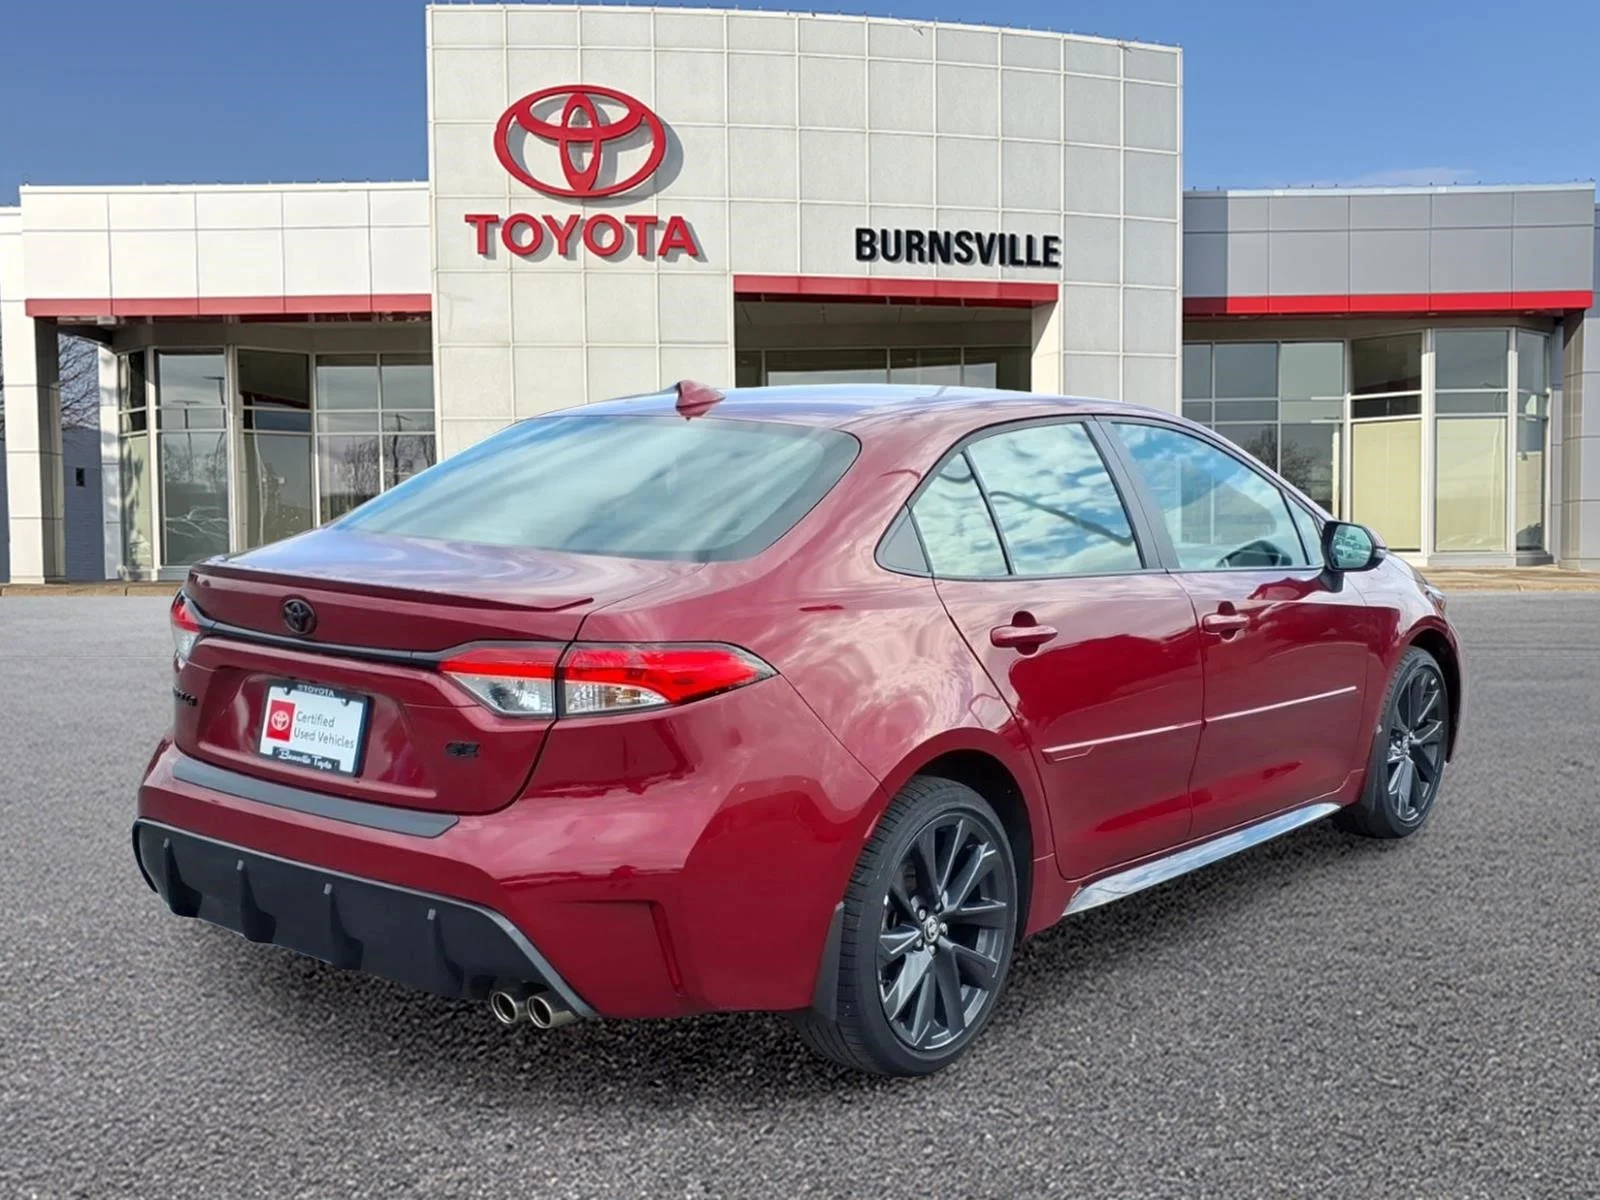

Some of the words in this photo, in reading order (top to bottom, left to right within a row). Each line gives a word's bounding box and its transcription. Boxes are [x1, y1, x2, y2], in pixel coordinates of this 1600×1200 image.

[464, 213, 699, 257] TOYOTA
[855, 227, 1062, 268] BURNSVILLE
[303, 684, 335, 698] TOYOTA
[296, 711, 336, 728] Certified
[294, 727, 316, 741] Used
[318, 731, 355, 749] Vehicles
